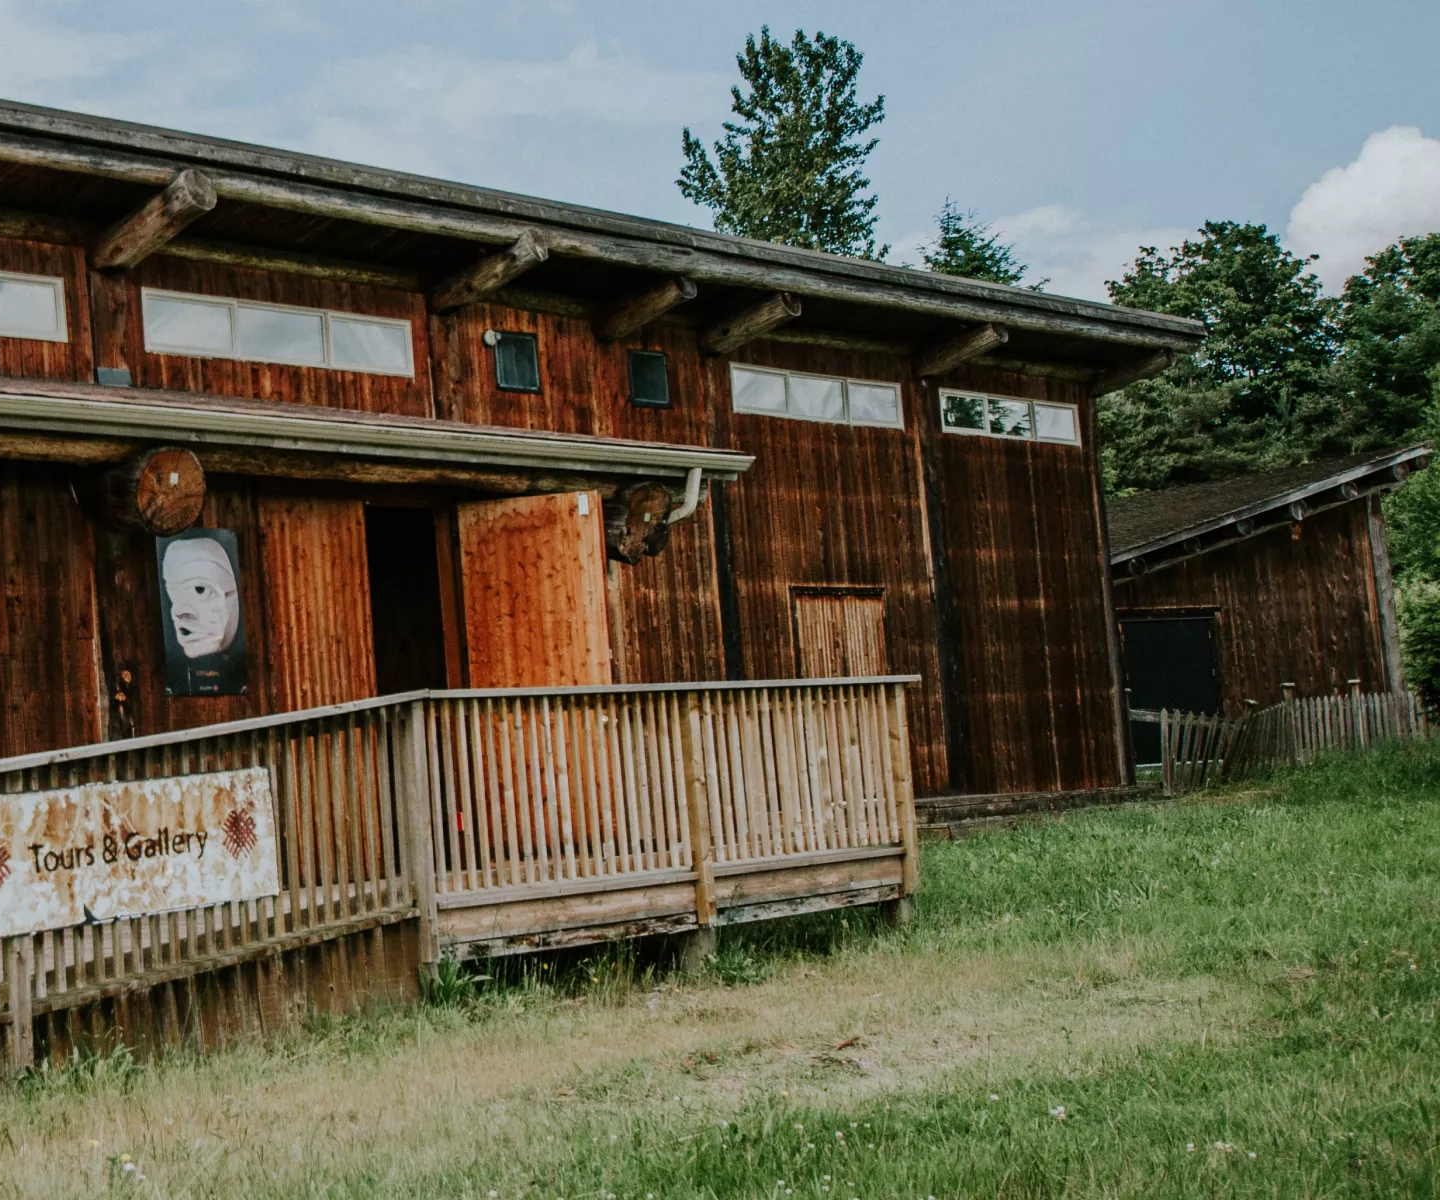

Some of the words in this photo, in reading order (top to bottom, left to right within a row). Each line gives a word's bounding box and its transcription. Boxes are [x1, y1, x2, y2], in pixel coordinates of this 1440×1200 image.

[28, 843, 95, 873] Tours
[102, 834, 118, 864] &
[124, 826, 208, 861] Gallery
